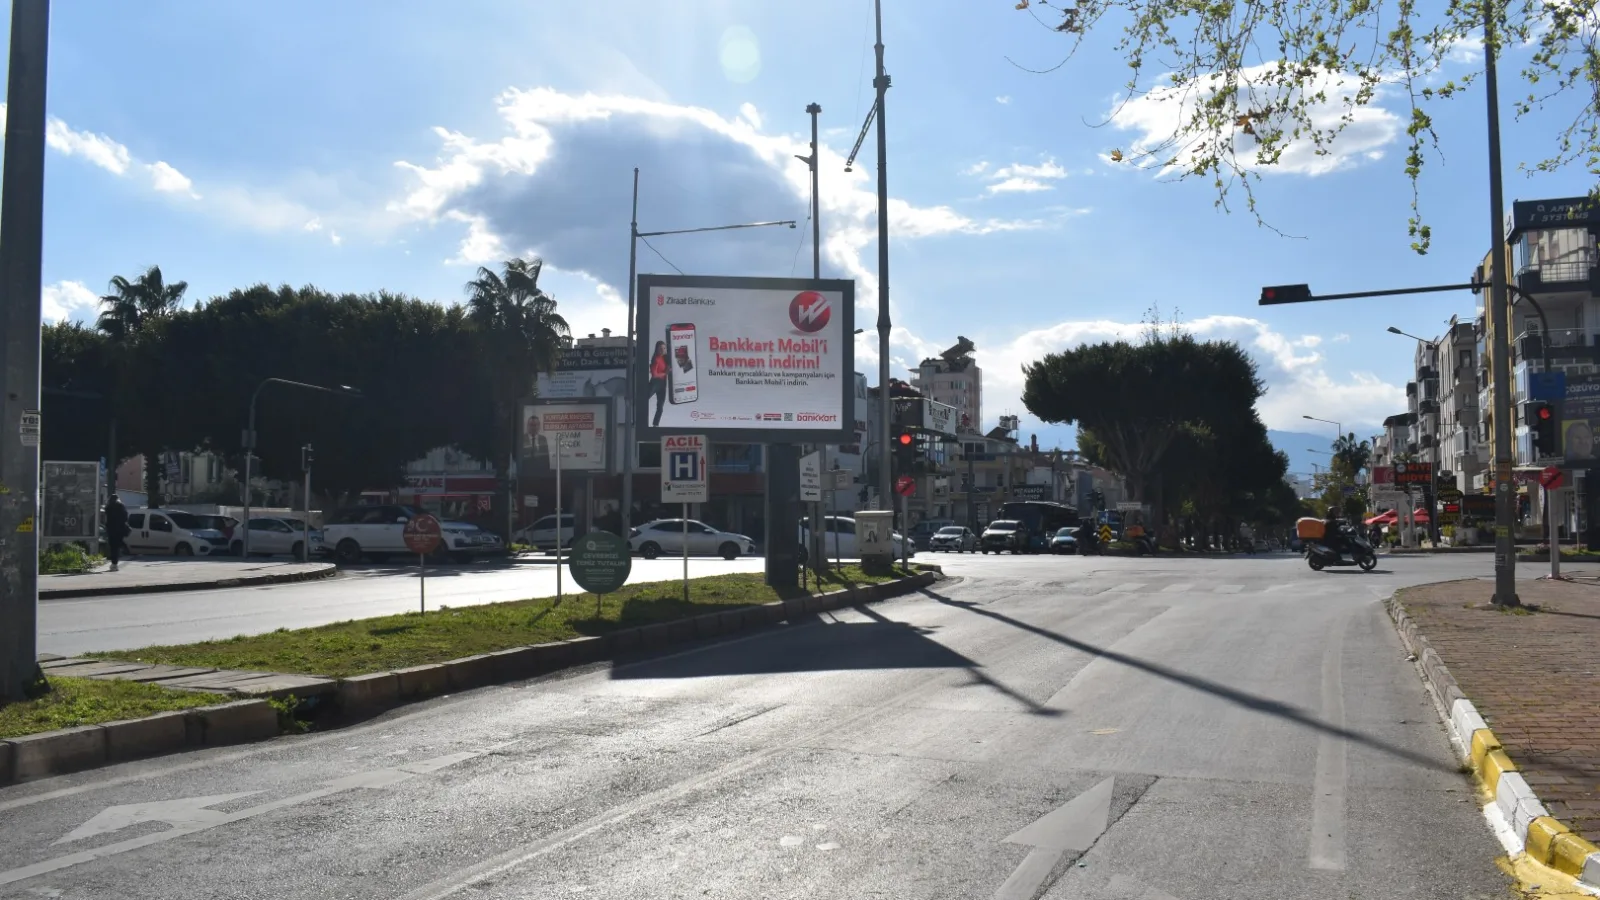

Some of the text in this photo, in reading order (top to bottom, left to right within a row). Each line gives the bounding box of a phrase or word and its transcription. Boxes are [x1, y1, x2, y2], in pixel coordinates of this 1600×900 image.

[1542, 212, 1588, 222] SYSTMS
[666, 296, 716, 306] Ziraat Bankası
[709, 336, 774, 352] Bankkart
[716, 353, 820, 369] hemen indirin!
[708, 369, 736, 377] Bankkart
[797, 413, 836, 422] bankkart
[675, 455, 692, 477] H
